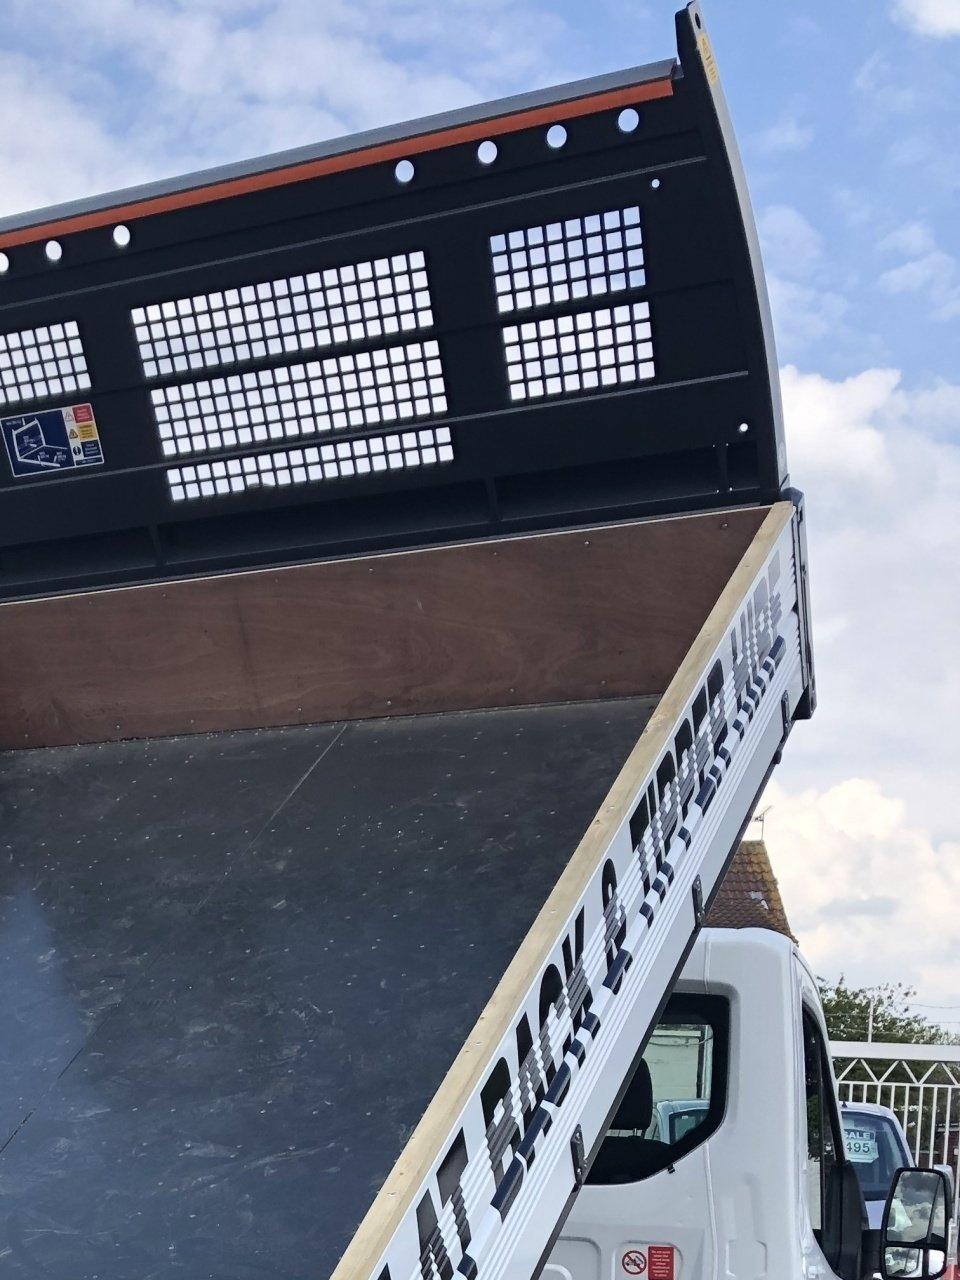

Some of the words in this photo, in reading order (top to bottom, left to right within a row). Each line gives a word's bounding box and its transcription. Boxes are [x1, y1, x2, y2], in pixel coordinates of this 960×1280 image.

[480, 905, 602, 1223] BACK
[629, 656, 733, 928] TIPPER
[730, 549, 786, 735] HIRE
